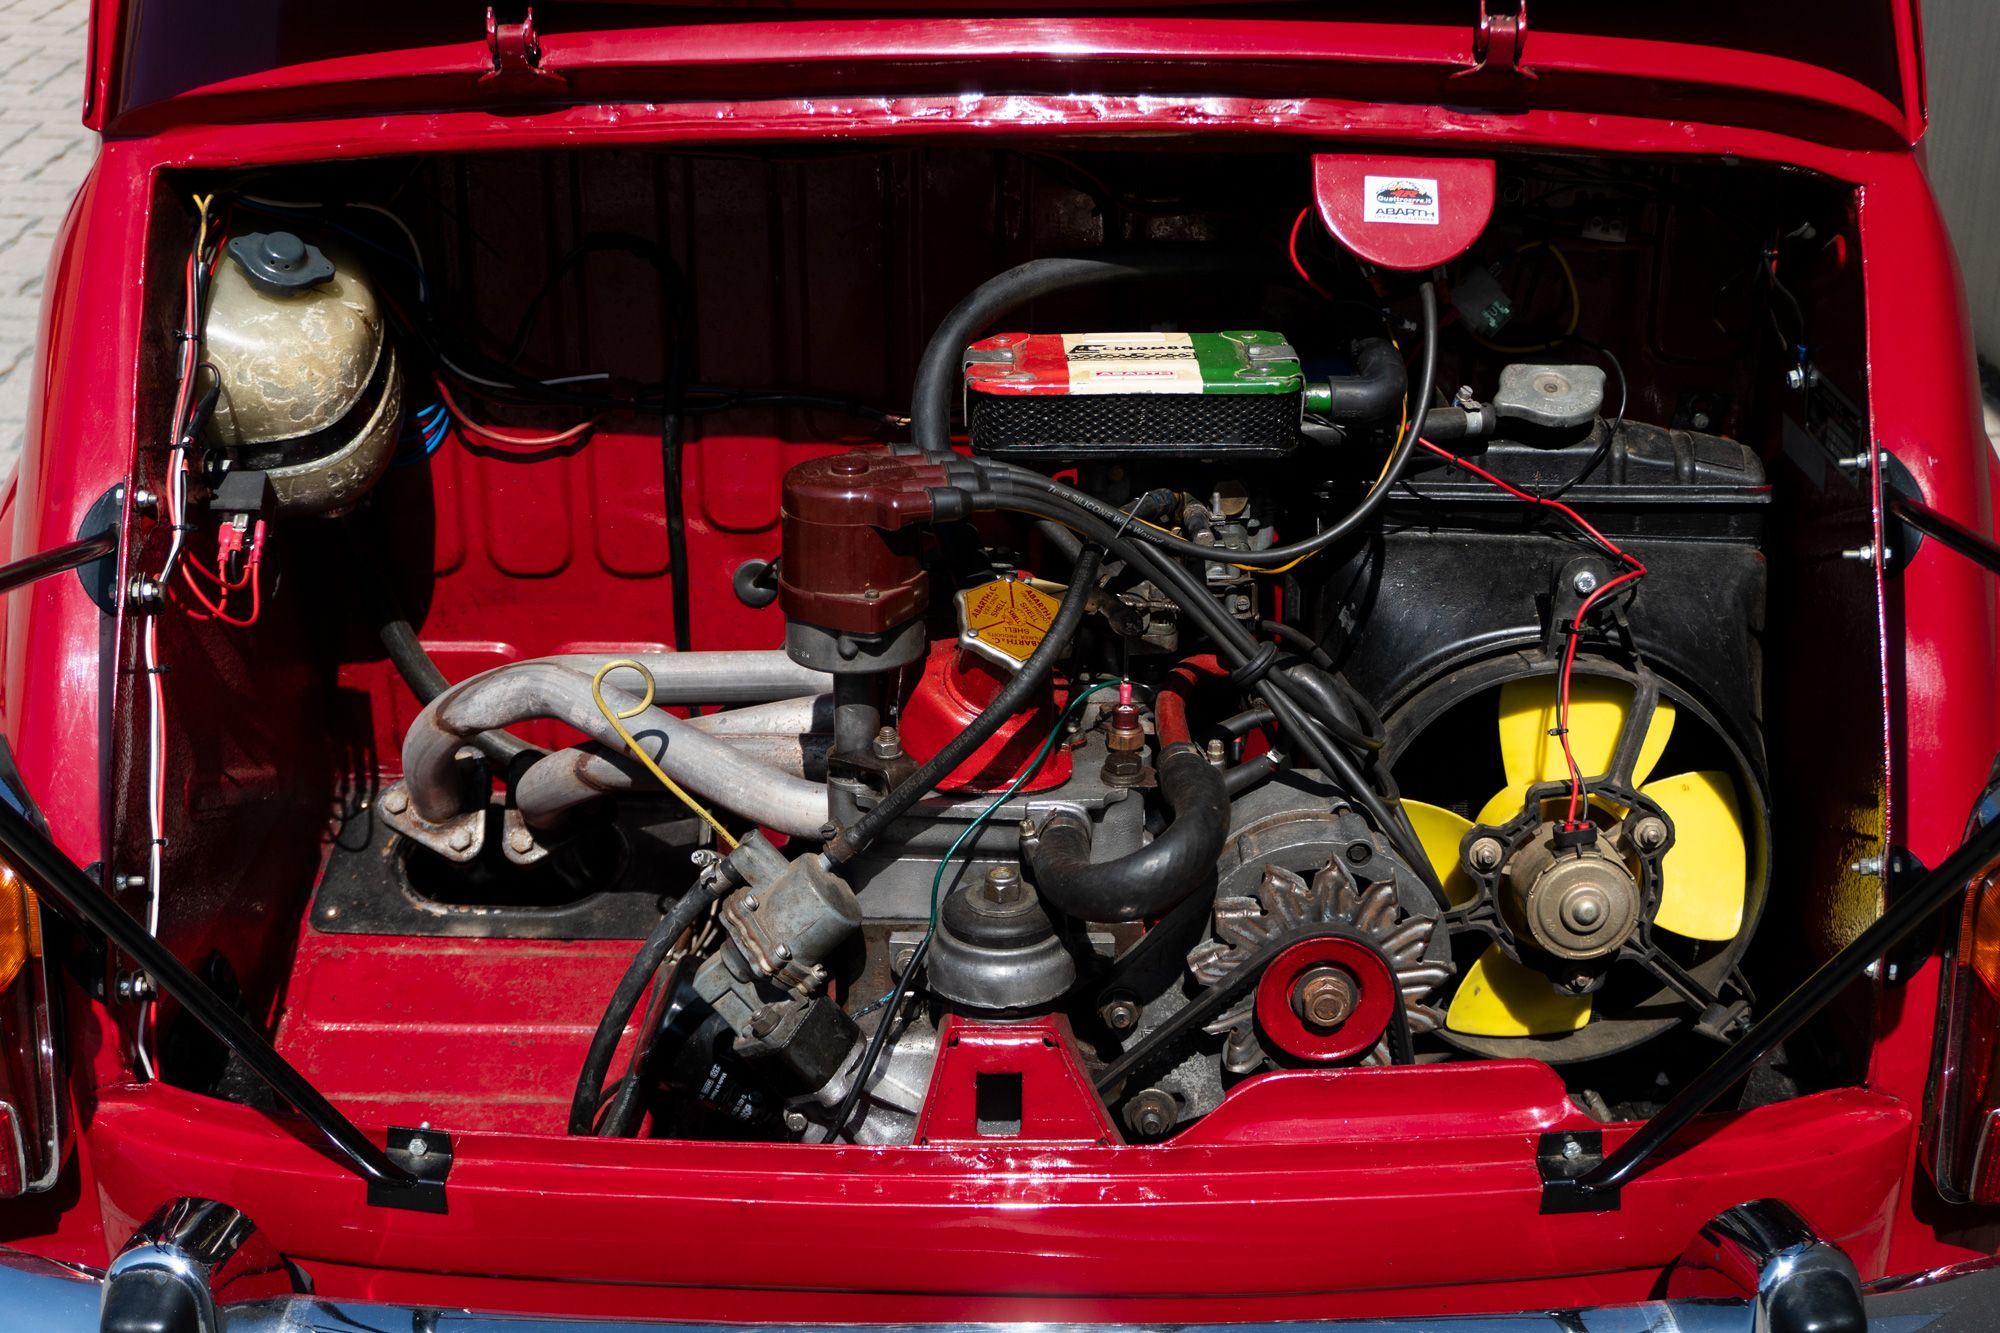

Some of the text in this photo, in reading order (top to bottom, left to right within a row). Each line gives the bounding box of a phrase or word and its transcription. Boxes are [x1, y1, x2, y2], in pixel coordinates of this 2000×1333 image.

[1375, 208, 1434, 216] ABARTH
[1071, 493, 1114, 518] SILICONE
[1133, 524, 1164, 544] Wound
[972, 593, 991, 618] ABARTH
[990, 600, 1007, 618] SHELL
[1020, 602, 1039, 622] SHELL
[1025, 589, 1049, 616] ABARTH
[1019, 655, 1042, 681] GATES
